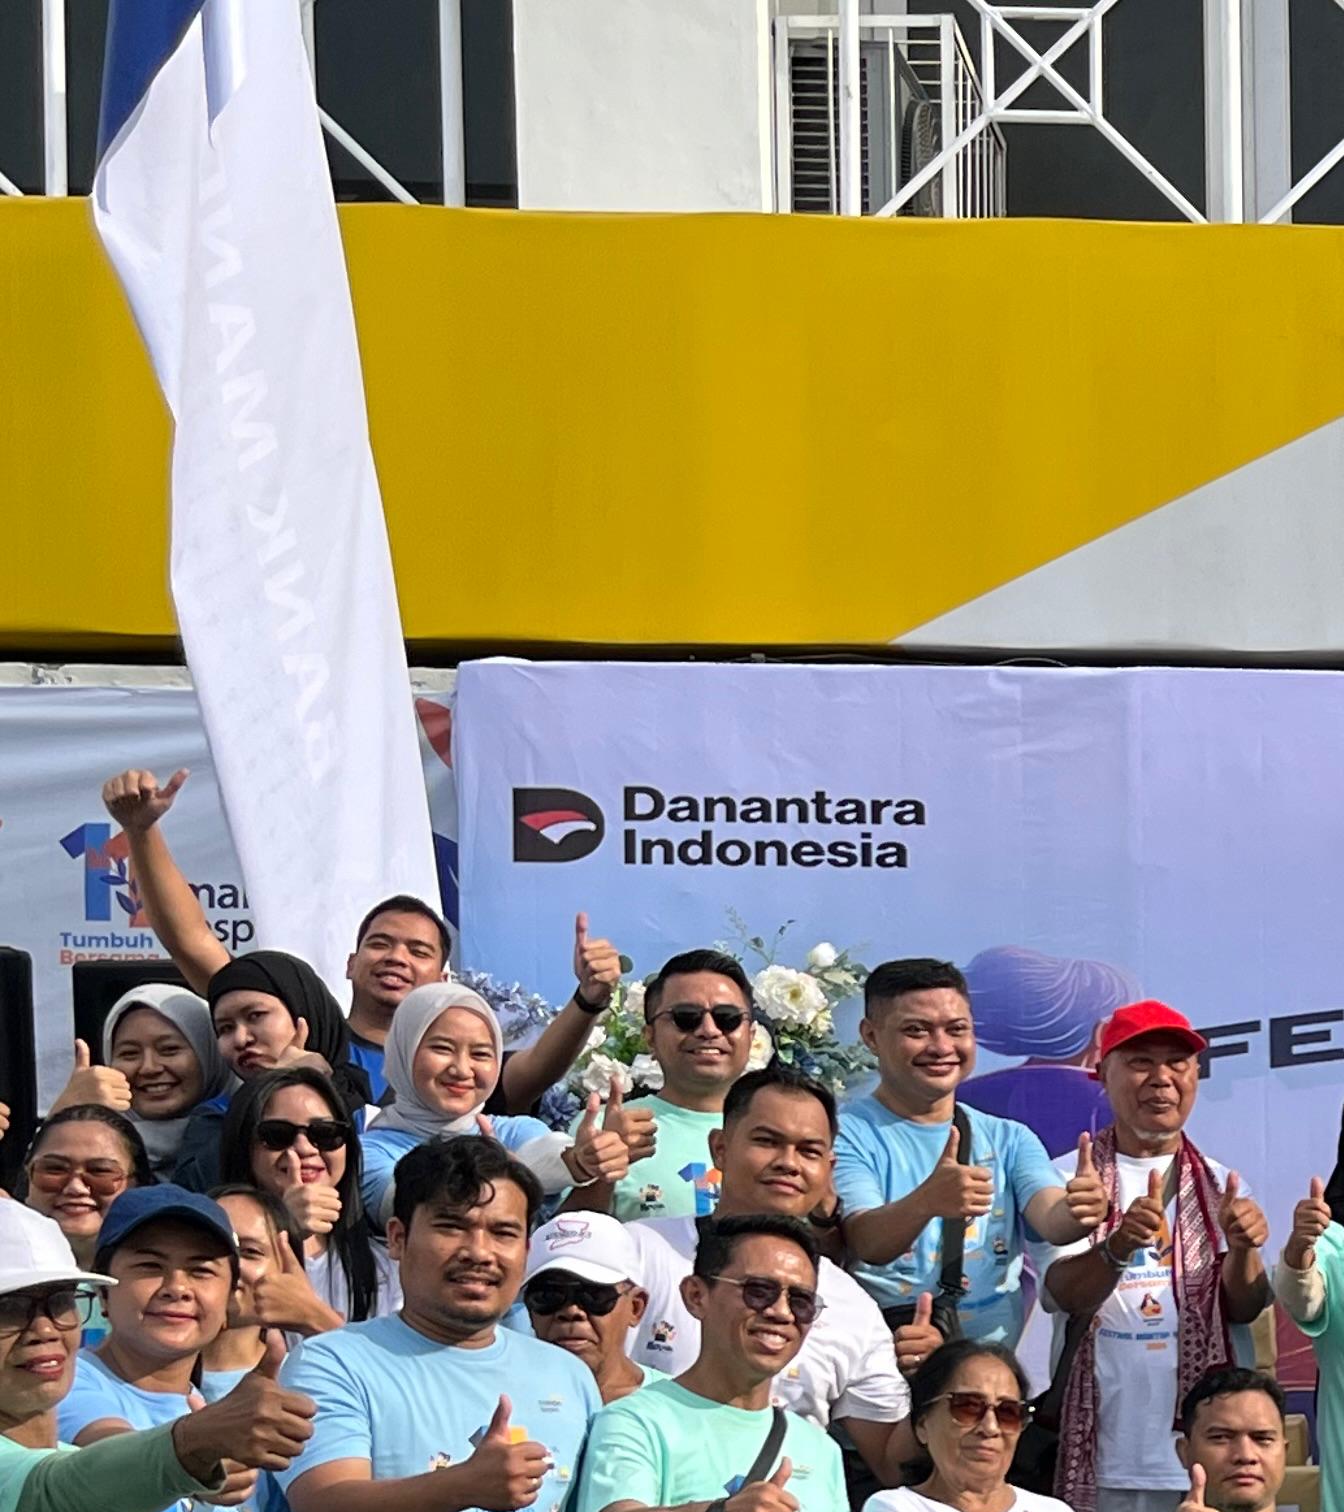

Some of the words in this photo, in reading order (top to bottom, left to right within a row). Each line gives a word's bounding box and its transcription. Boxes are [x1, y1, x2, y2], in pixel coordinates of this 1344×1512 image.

[623, 786, 926, 826] Danantara
[623, 828, 908, 868] Indonesia
[59, 932, 153, 949] Tumbuh
